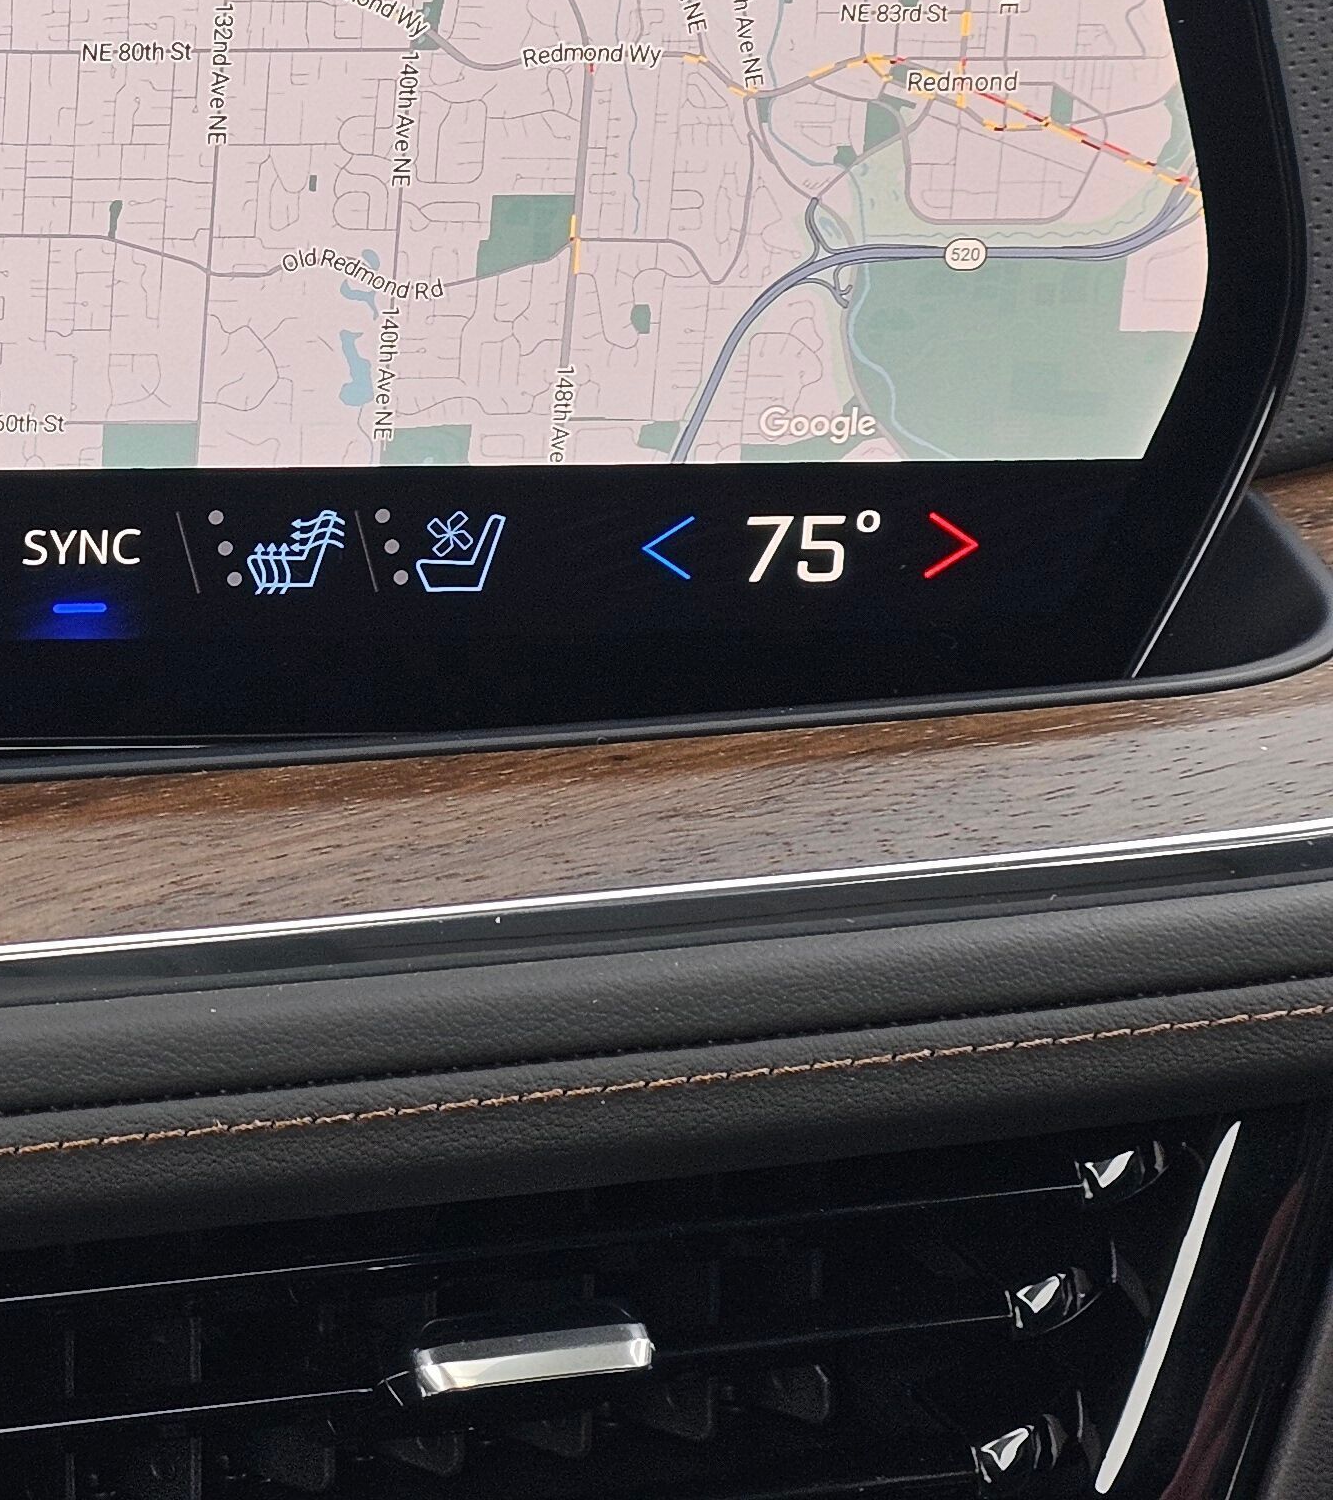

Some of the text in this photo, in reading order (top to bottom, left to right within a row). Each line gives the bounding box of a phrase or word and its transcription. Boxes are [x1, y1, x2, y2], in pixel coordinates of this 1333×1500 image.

[392, 6, 429, 37] Wy
[684, 0, 708, 33] NE
[840, 5, 948, 22] NE 83rd St
[82, 43, 191, 61] NE 80th St
[735, 15, 759, 58] Ave
[206, 3, 235, 144] 132nd Ave NE
[523, 44, 661, 68] Redmond Wy
[743, 56, 765, 88] NE
[907, 72, 1018, 92] Redmond
[391, 52, 421, 188] 140th Ave NE
[950, 247, 981, 262] 520
[282, 249, 444, 300] Old Redmond Rd
[374, 307, 400, 439] 140th Ave NE
[41, 415, 65, 433] St
[549, 366, 578, 463] 148th Ave
[759, 406, 877, 444] Google
[22, 529, 141, 566] SYNC
[747, 509, 882, 583] 75°
